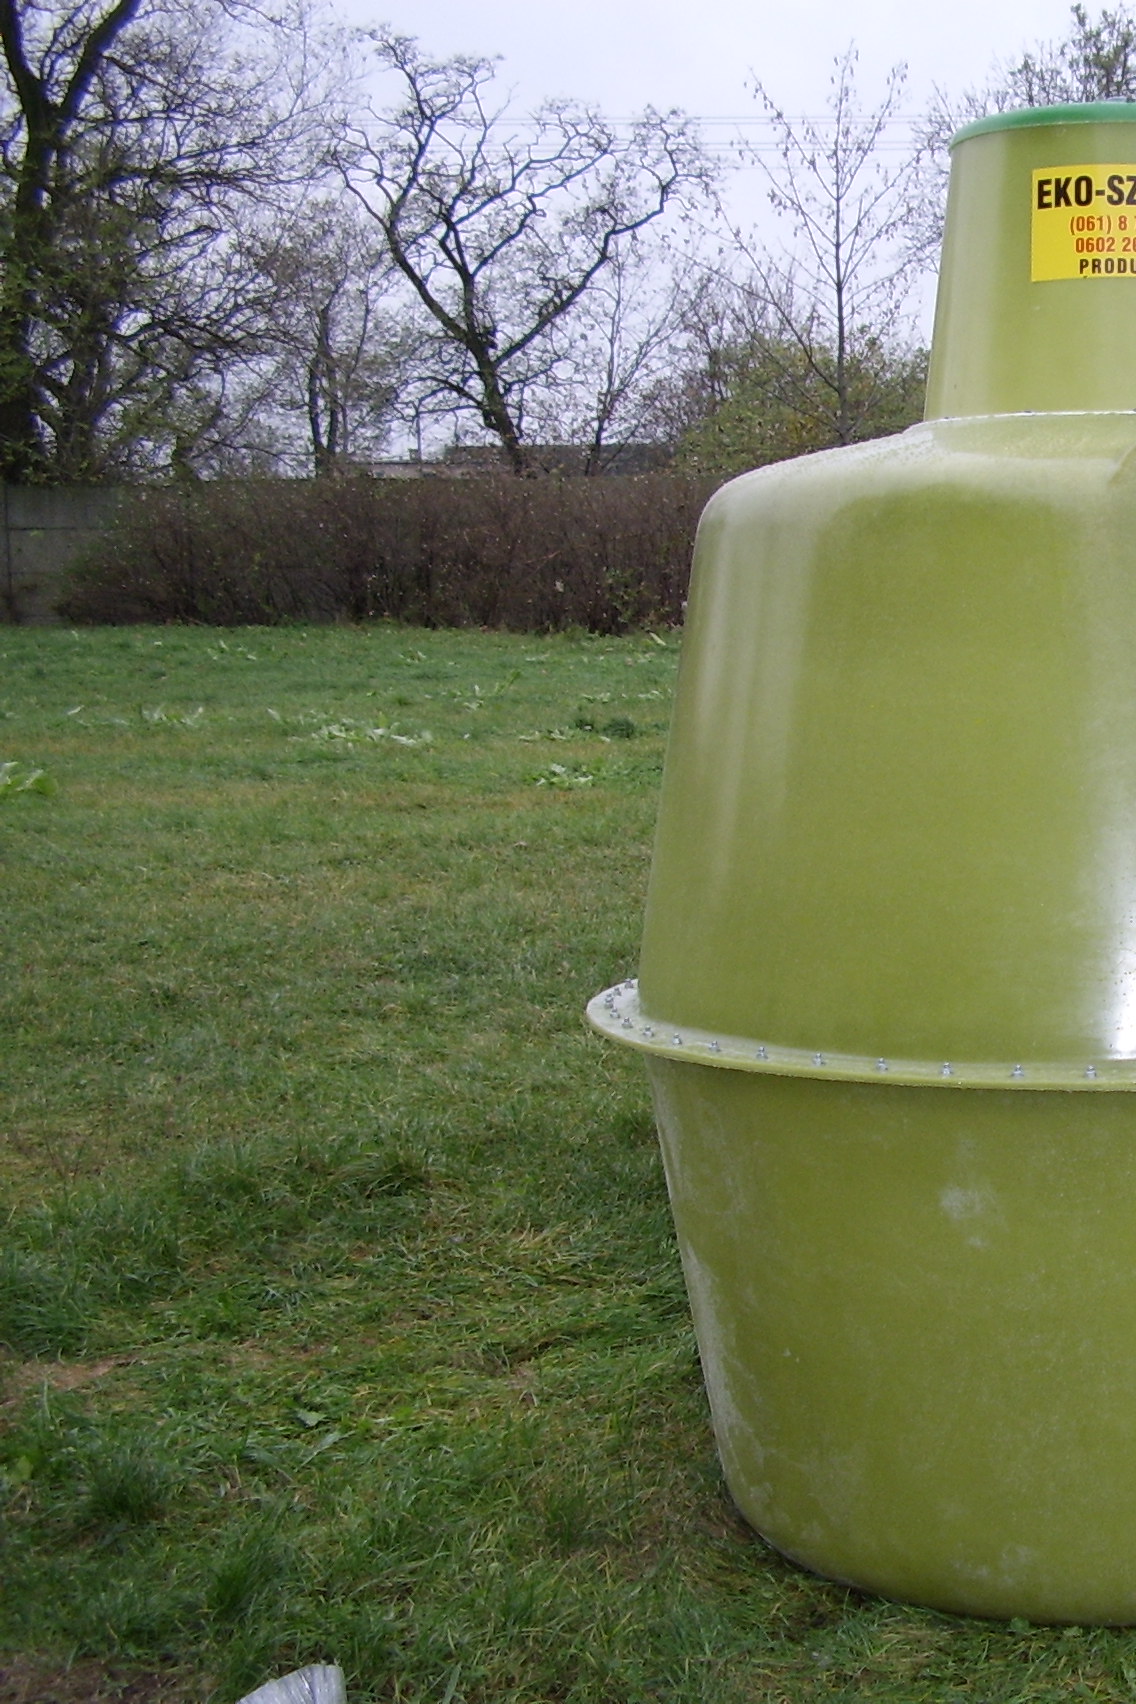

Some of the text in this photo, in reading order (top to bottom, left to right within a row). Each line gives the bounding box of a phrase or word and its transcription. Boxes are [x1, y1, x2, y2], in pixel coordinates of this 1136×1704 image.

[1070, 215, 1112, 235] (061)
[1118, 217, 1128, 232] 8
[1075, 237, 1115, 253] 0602
